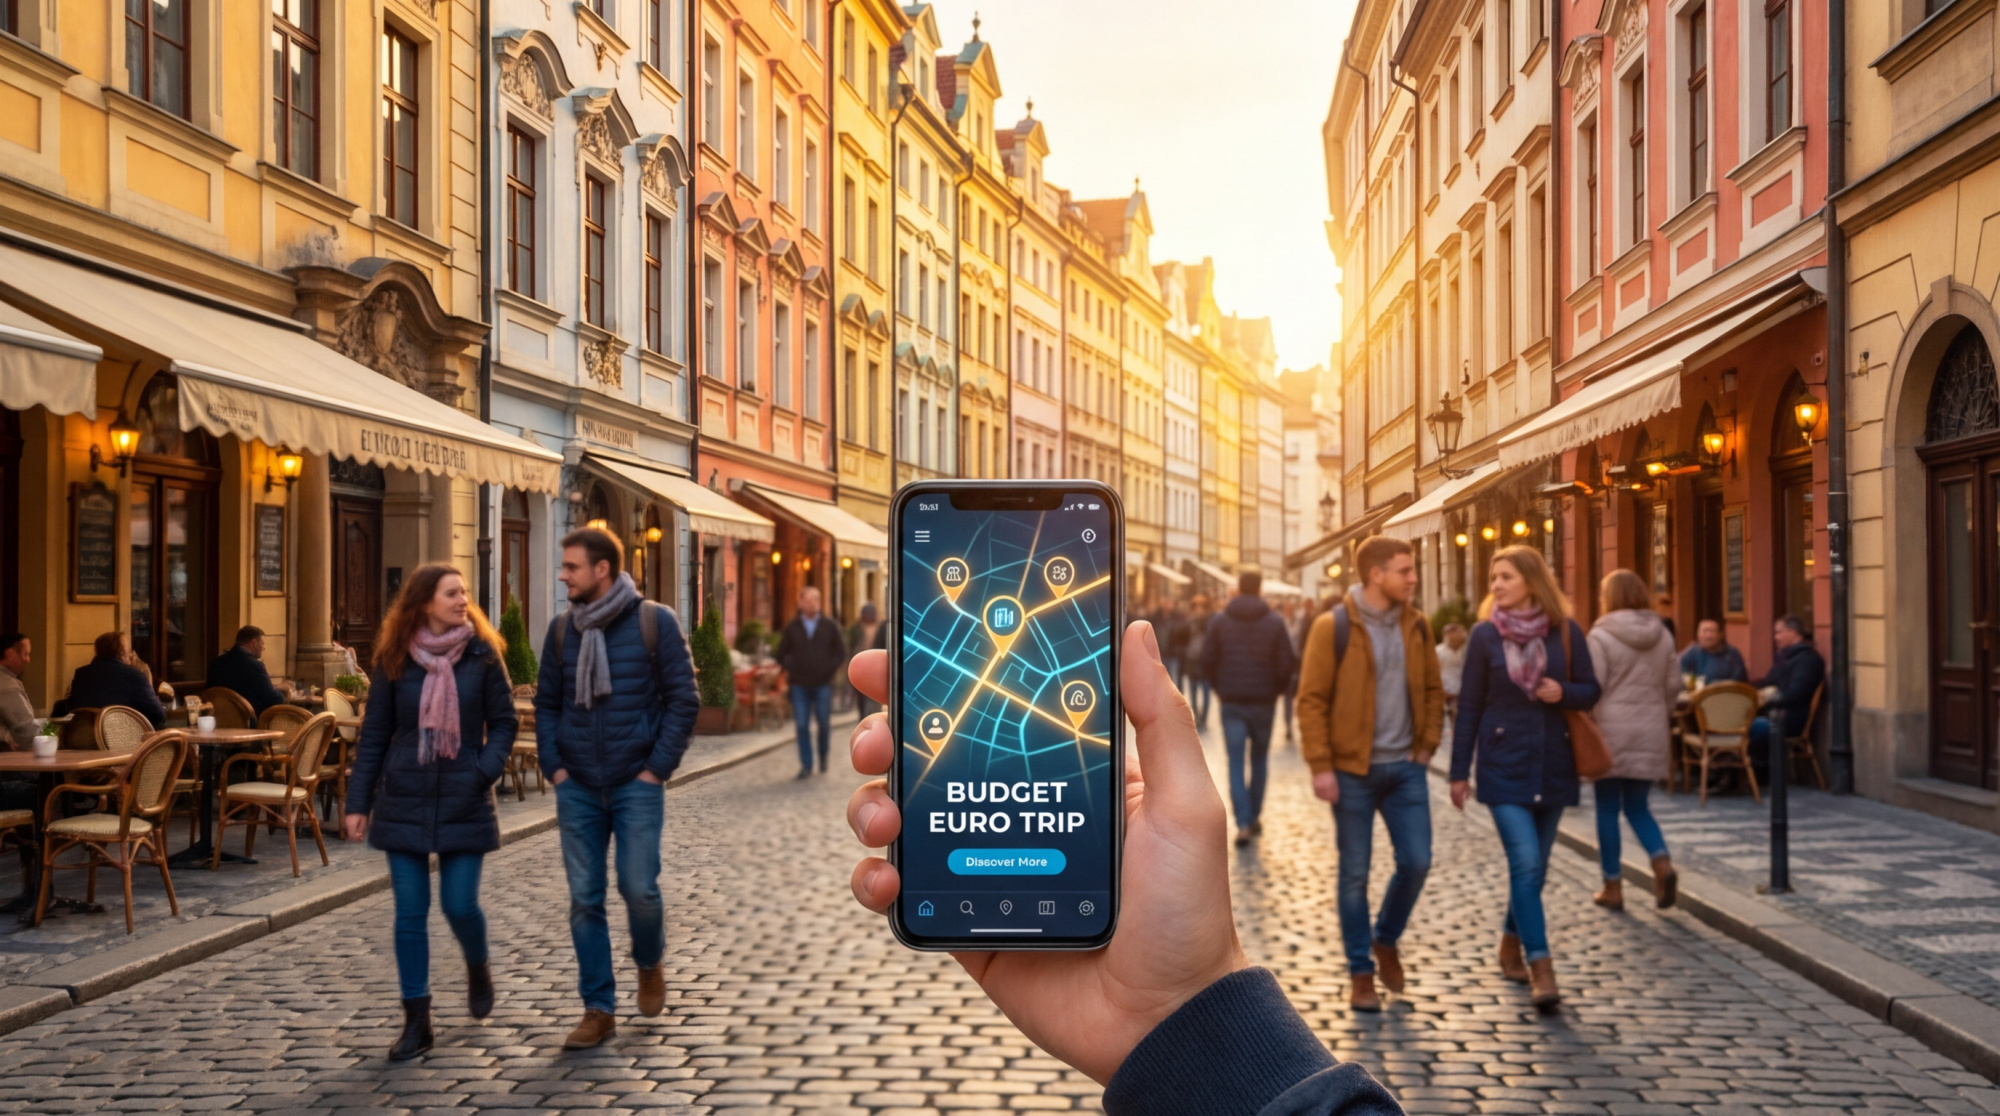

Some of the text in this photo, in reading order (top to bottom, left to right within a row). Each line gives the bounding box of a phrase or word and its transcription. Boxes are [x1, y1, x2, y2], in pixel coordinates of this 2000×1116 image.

[947, 781, 1068, 803] BUDGET
[929, 811, 1085, 833] EURO TRIP
[966, 857, 1048, 867] Discover More
